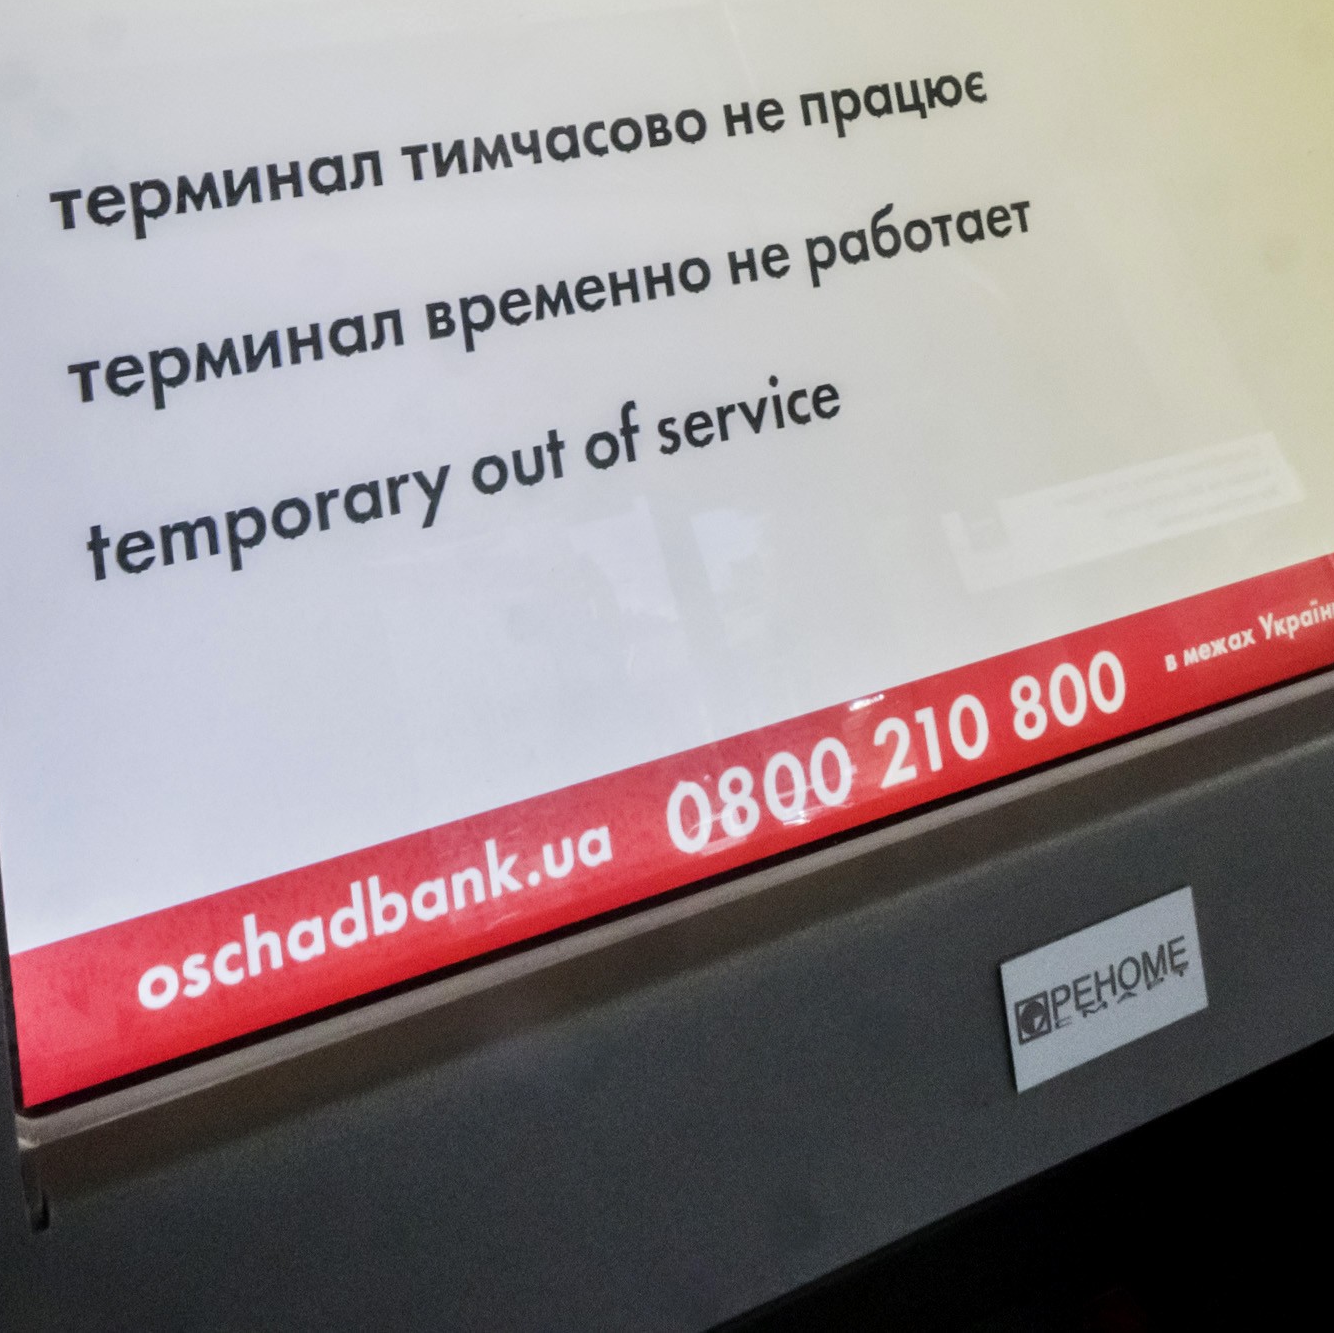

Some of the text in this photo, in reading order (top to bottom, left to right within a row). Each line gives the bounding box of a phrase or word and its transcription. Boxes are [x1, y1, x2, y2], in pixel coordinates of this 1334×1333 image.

[50, 72, 988, 240] терминал тимчасово не працює
[68, 201, 1031, 410] терминал временно не работает
[87, 375, 841, 581] temporary out of service
[137, 823, 612, 1011] oschadbank.ua
[666, 735, 853, 856] 0800
[871, 693, 988, 789] 210
[1009, 650, 1127, 742] 800
[1164, 653, 1178, 673] в
[1183, 627, 1256, 669] межах
[1051, 935, 1189, 1021] РЕНОМЕ
